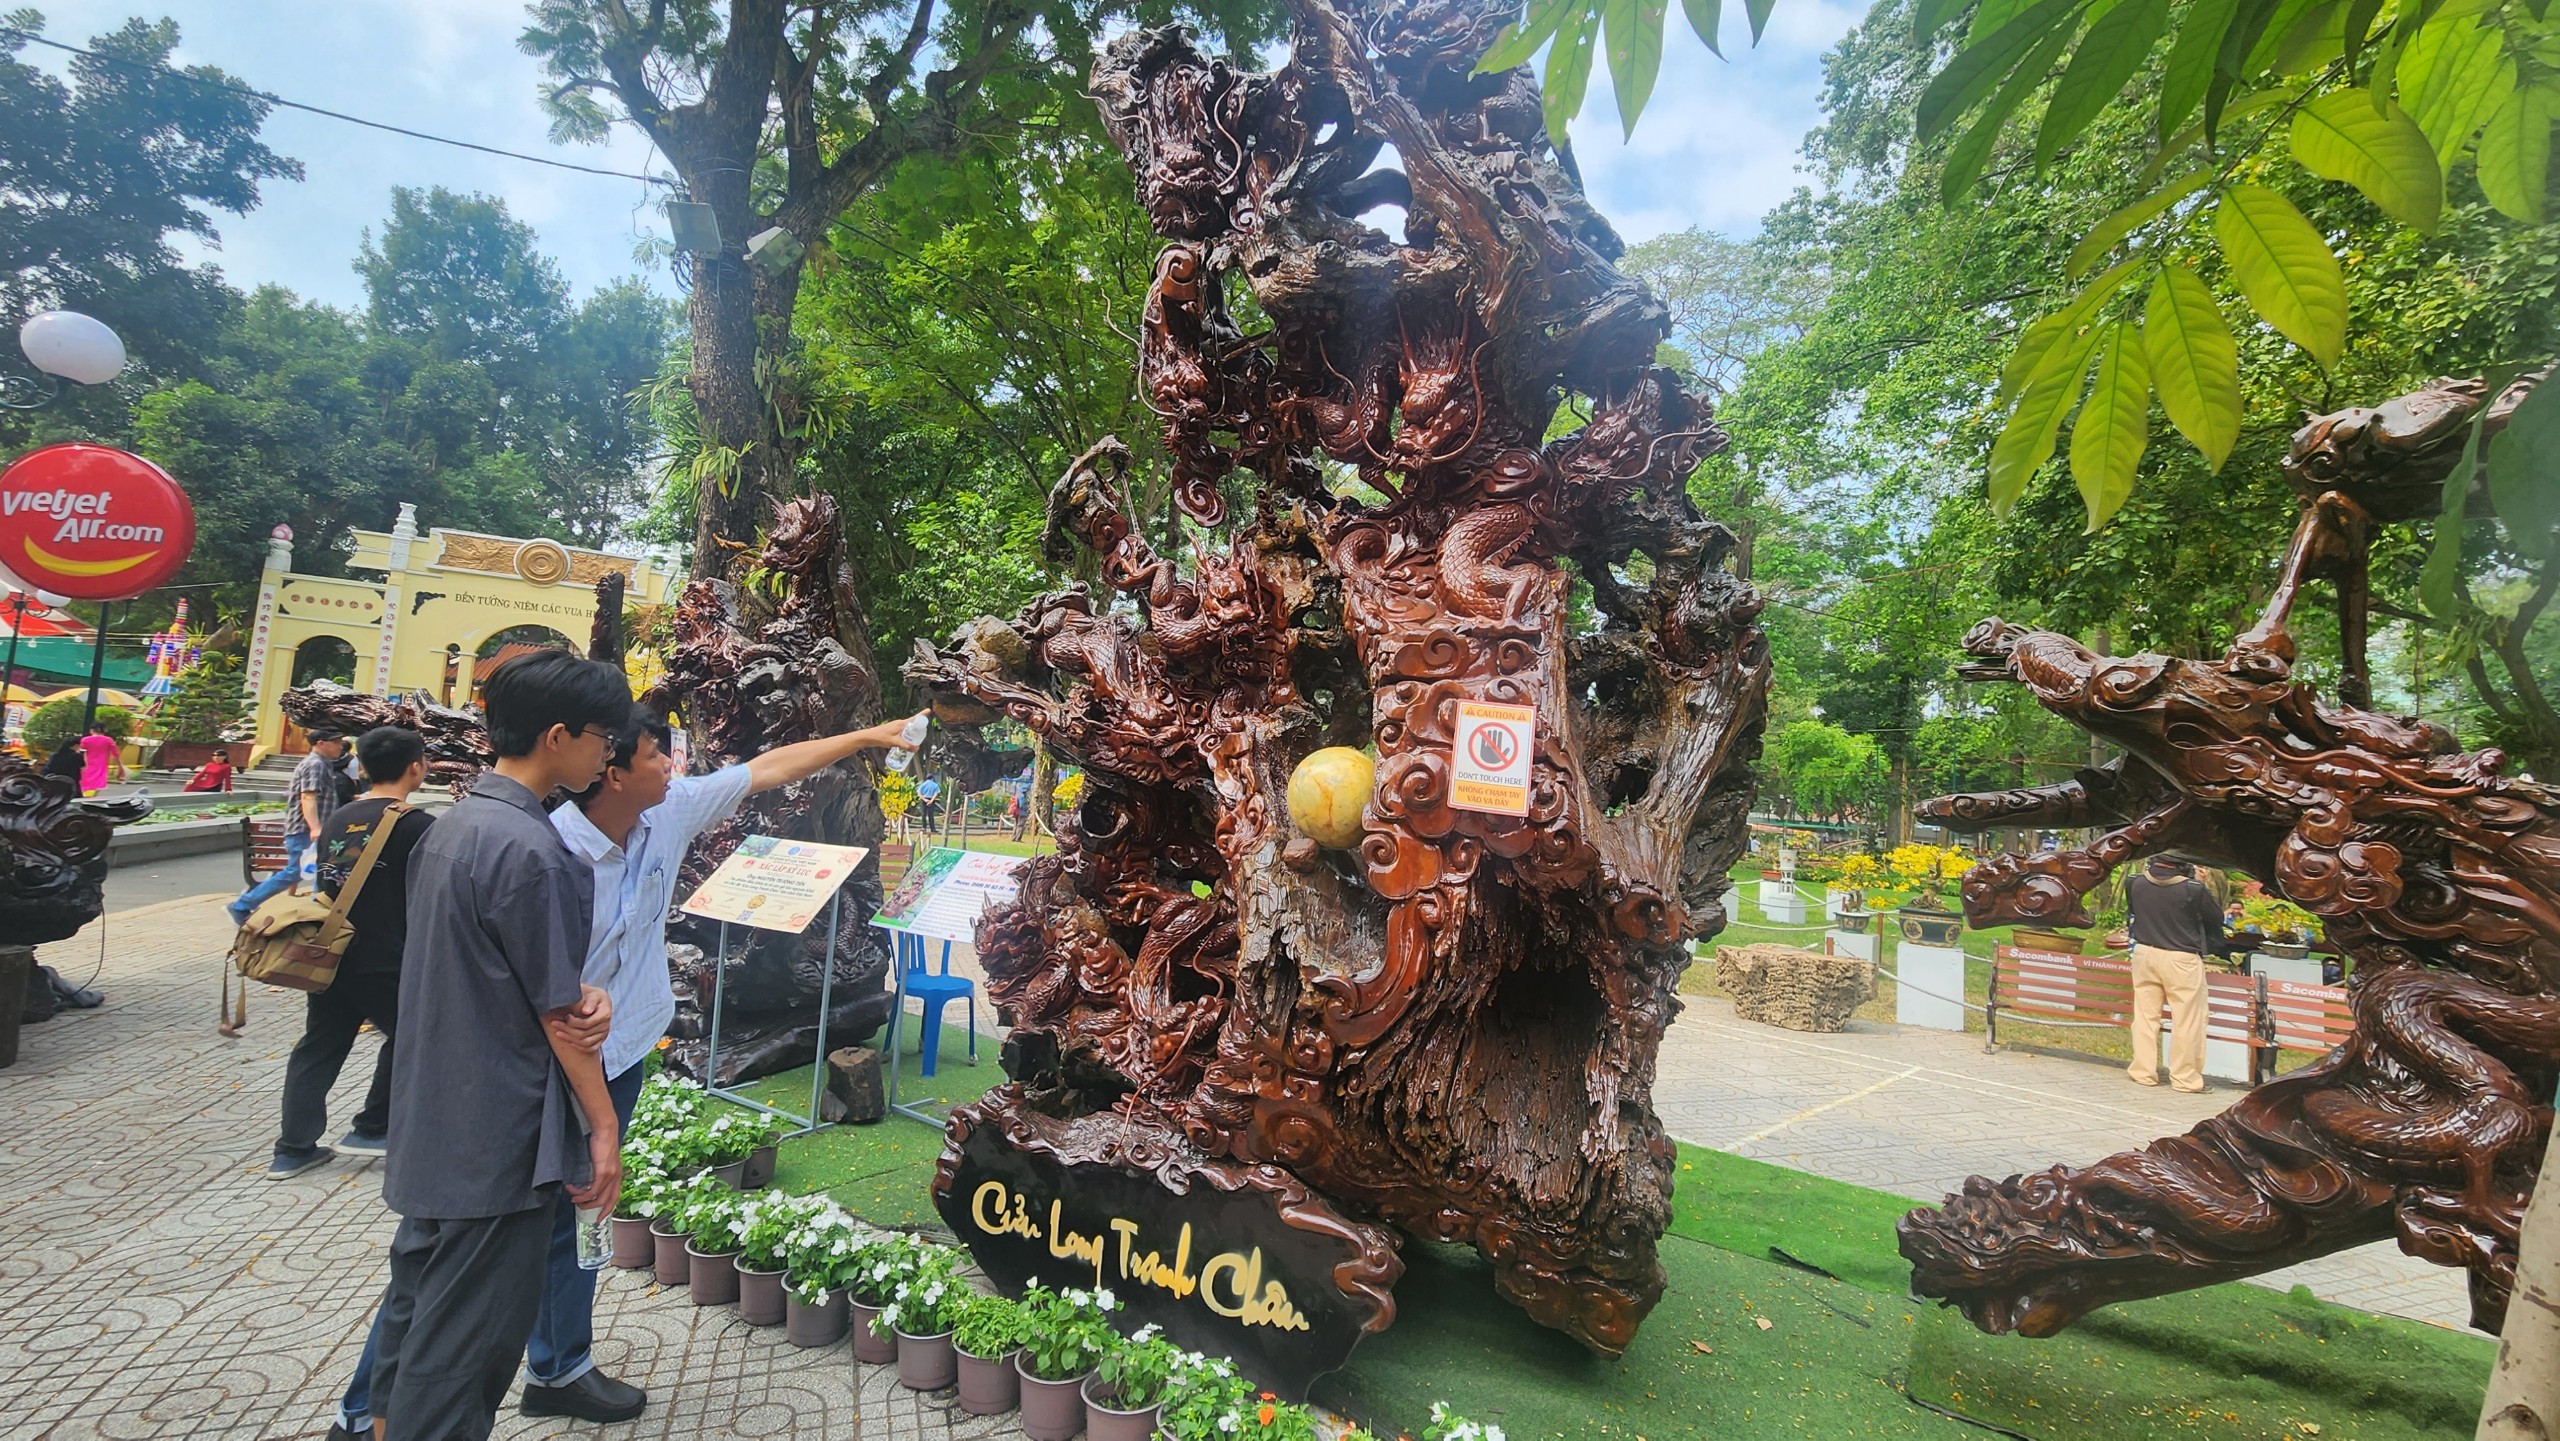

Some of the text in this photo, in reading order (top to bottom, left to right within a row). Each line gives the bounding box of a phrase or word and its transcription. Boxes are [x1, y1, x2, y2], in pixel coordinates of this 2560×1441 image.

[53, 518, 163, 543] Air.com
[541, 604, 561, 614] CÁC
[564, 606, 583, 616] VUA
[1477, 709, 1515, 720] CAUTION
[1458, 771, 1523, 785] DON'T TOUCH HERE
[1509, 791, 1521, 799] TAY
[2009, 948, 2073, 965] Sacombank
[2281, 982, 2345, 1000] Sacomba
[1048, 1199, 1104, 1287] Long
[1200, 1246, 1310, 1331] Châu
